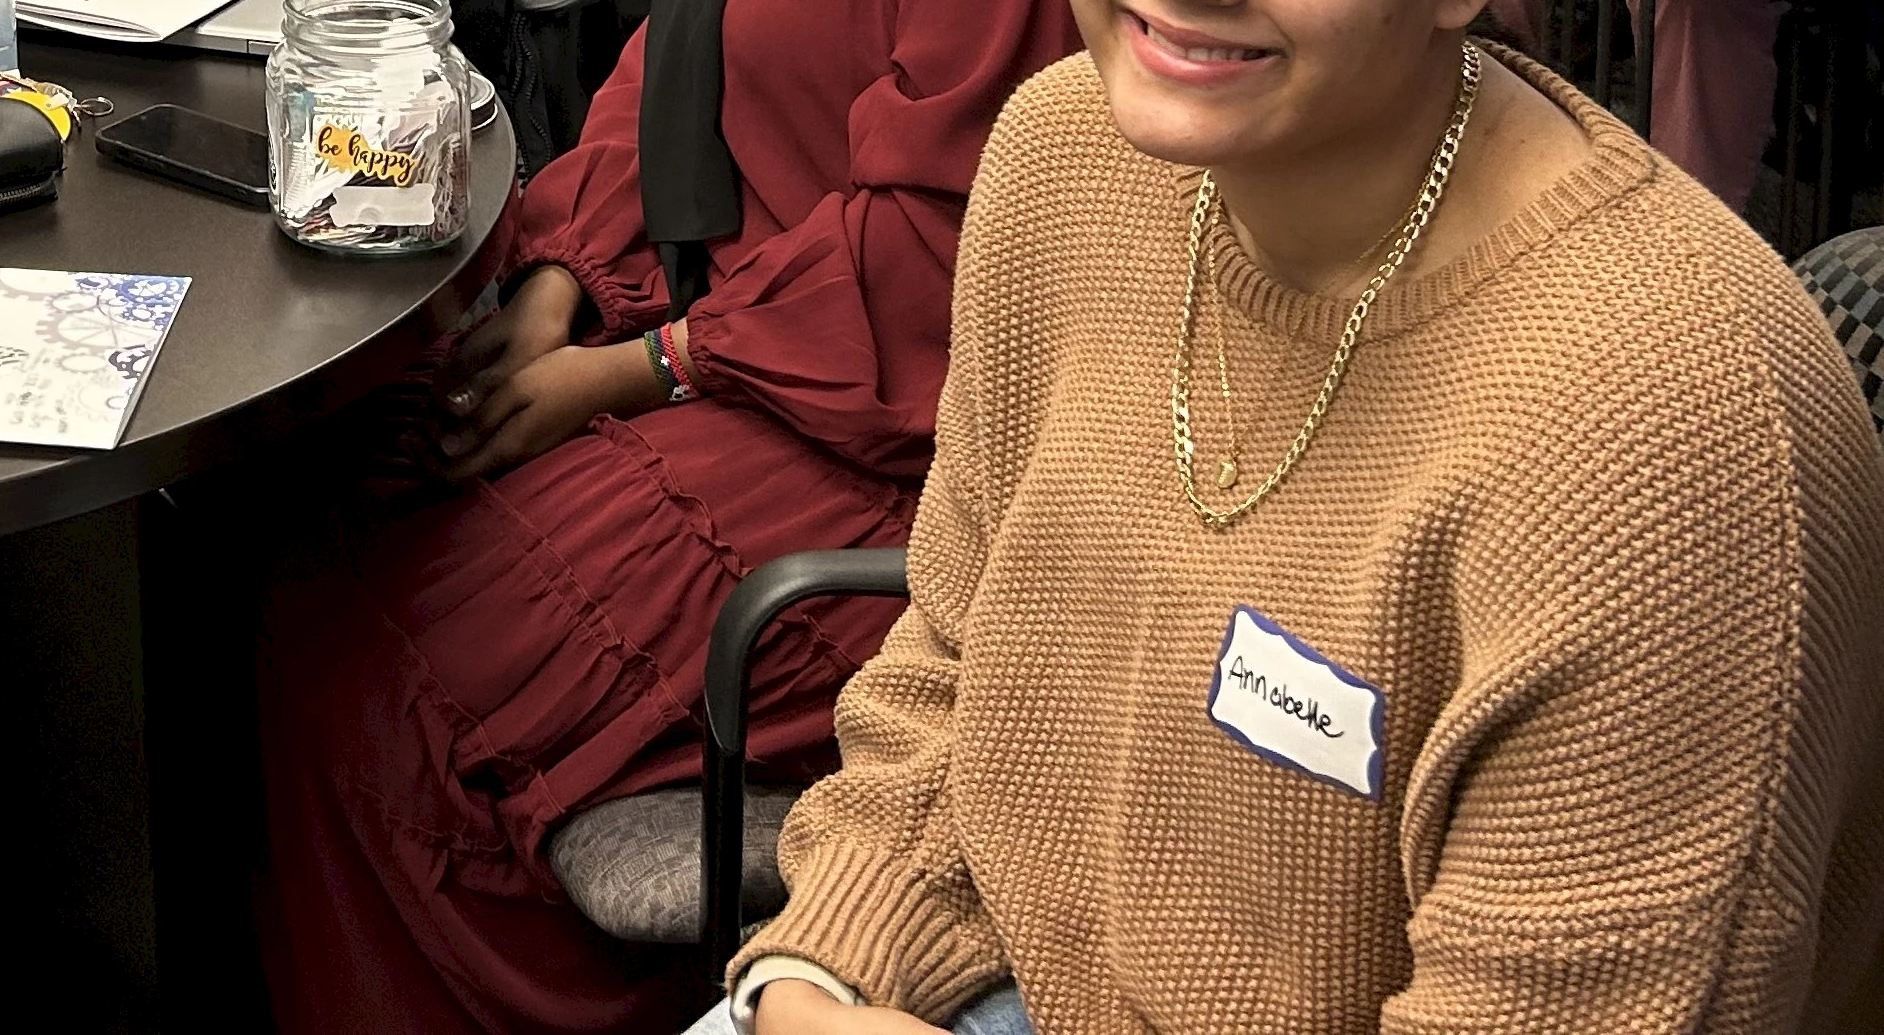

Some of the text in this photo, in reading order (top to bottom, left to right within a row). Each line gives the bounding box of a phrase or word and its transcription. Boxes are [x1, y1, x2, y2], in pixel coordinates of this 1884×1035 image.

[317, 126, 417, 183] be happy
[1227, 655, 1345, 738] Annabelle
